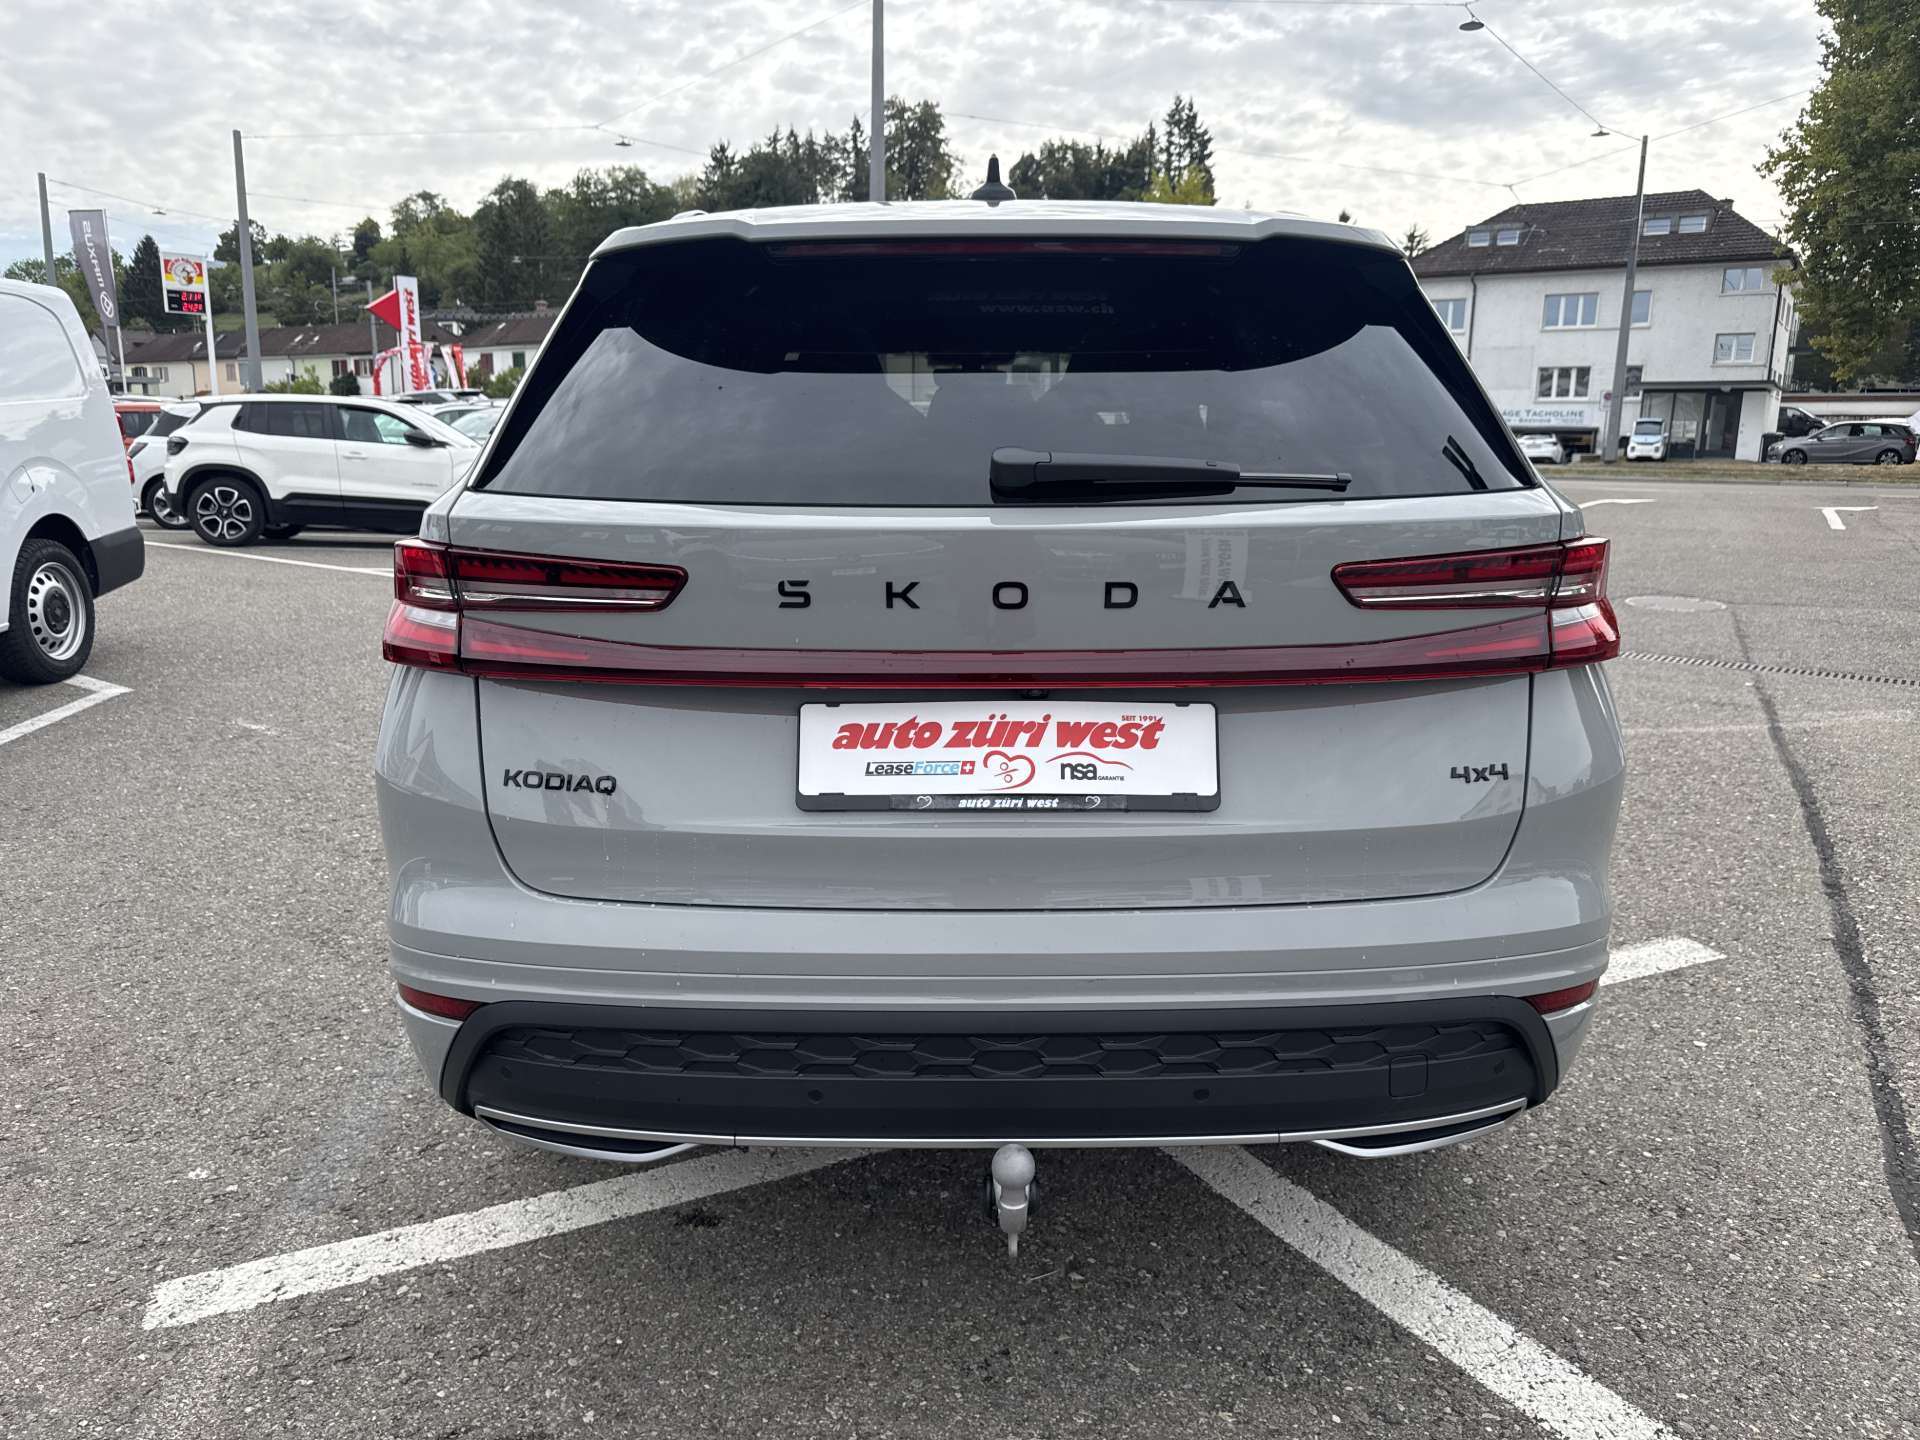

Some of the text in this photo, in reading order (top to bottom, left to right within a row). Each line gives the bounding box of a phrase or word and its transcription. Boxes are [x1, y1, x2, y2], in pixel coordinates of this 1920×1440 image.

[832, 714, 1166, 750] auto züri west
[865, 760, 961, 775] LeaseForce
[1060, 763, 1097, 781] nsa
[1450, 763, 1509, 784] 4x4
[503, 768, 617, 796] KODIAQ
[958, 797, 1059, 808] auto züri west
